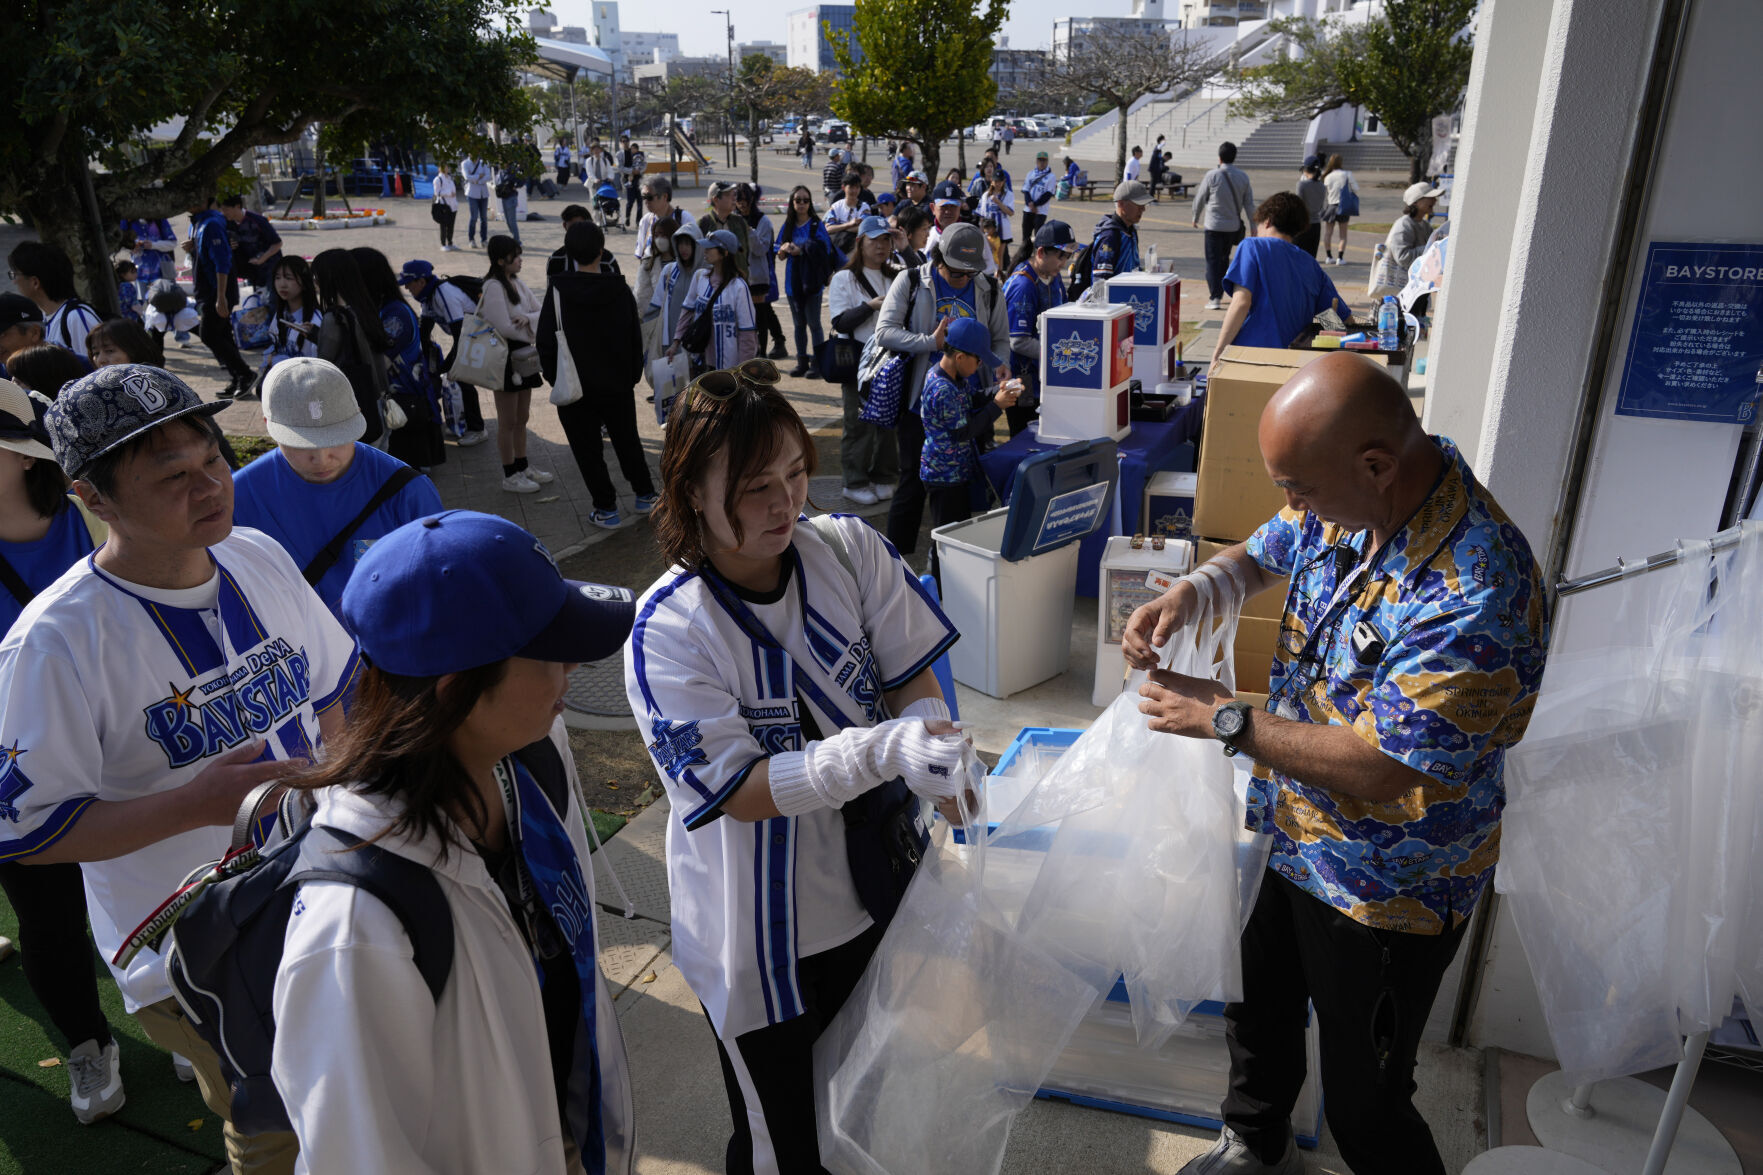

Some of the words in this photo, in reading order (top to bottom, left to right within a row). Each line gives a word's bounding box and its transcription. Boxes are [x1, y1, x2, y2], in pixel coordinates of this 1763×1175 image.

[459, 341, 487, 369] 19
[246, 637, 294, 675] DeNA
[143, 647, 310, 769] BAYSTAR
[1431, 763, 1452, 775] BAY
[129, 891, 192, 949] Orobianco
